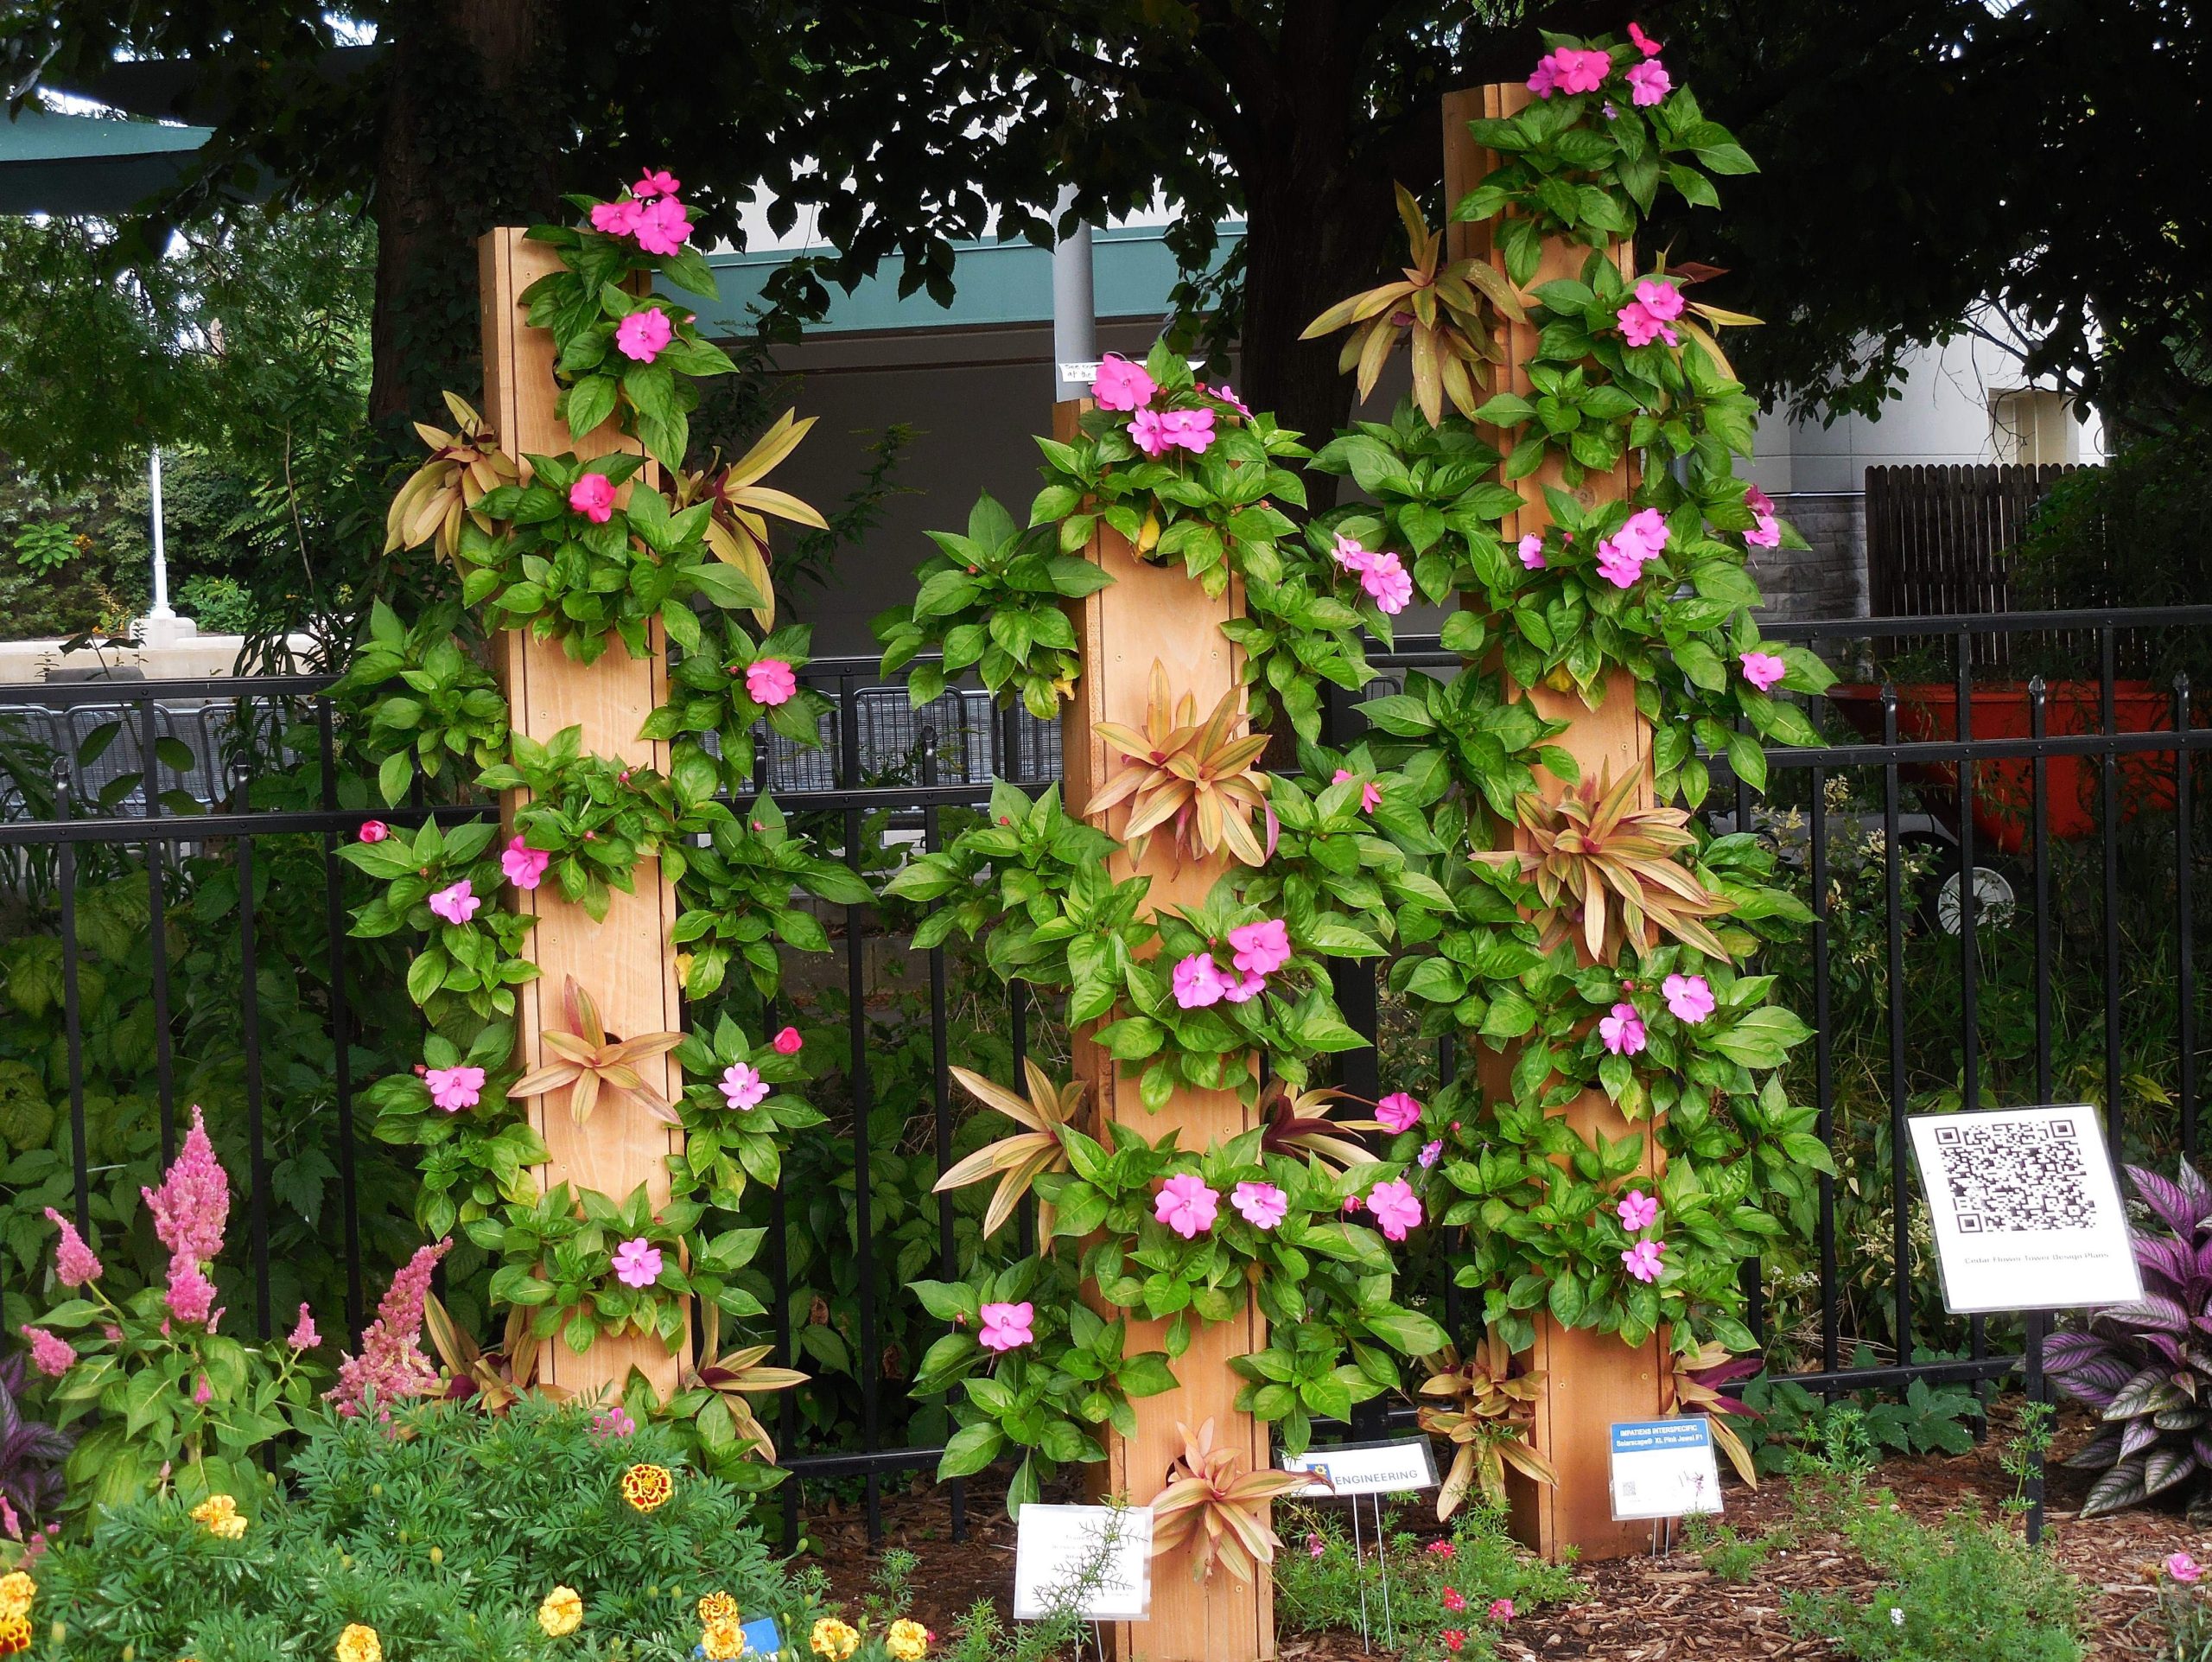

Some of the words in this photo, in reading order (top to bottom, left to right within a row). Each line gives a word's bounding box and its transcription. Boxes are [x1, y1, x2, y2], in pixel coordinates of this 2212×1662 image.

[1619, 1428, 1652, 1437] IMPATIENS
[1652, 1424, 1698, 1435] INTERSPECIFIC
[1678, 1434, 1694, 1442] Jewel
[1335, 1469, 1419, 1486] ENGINEERING
